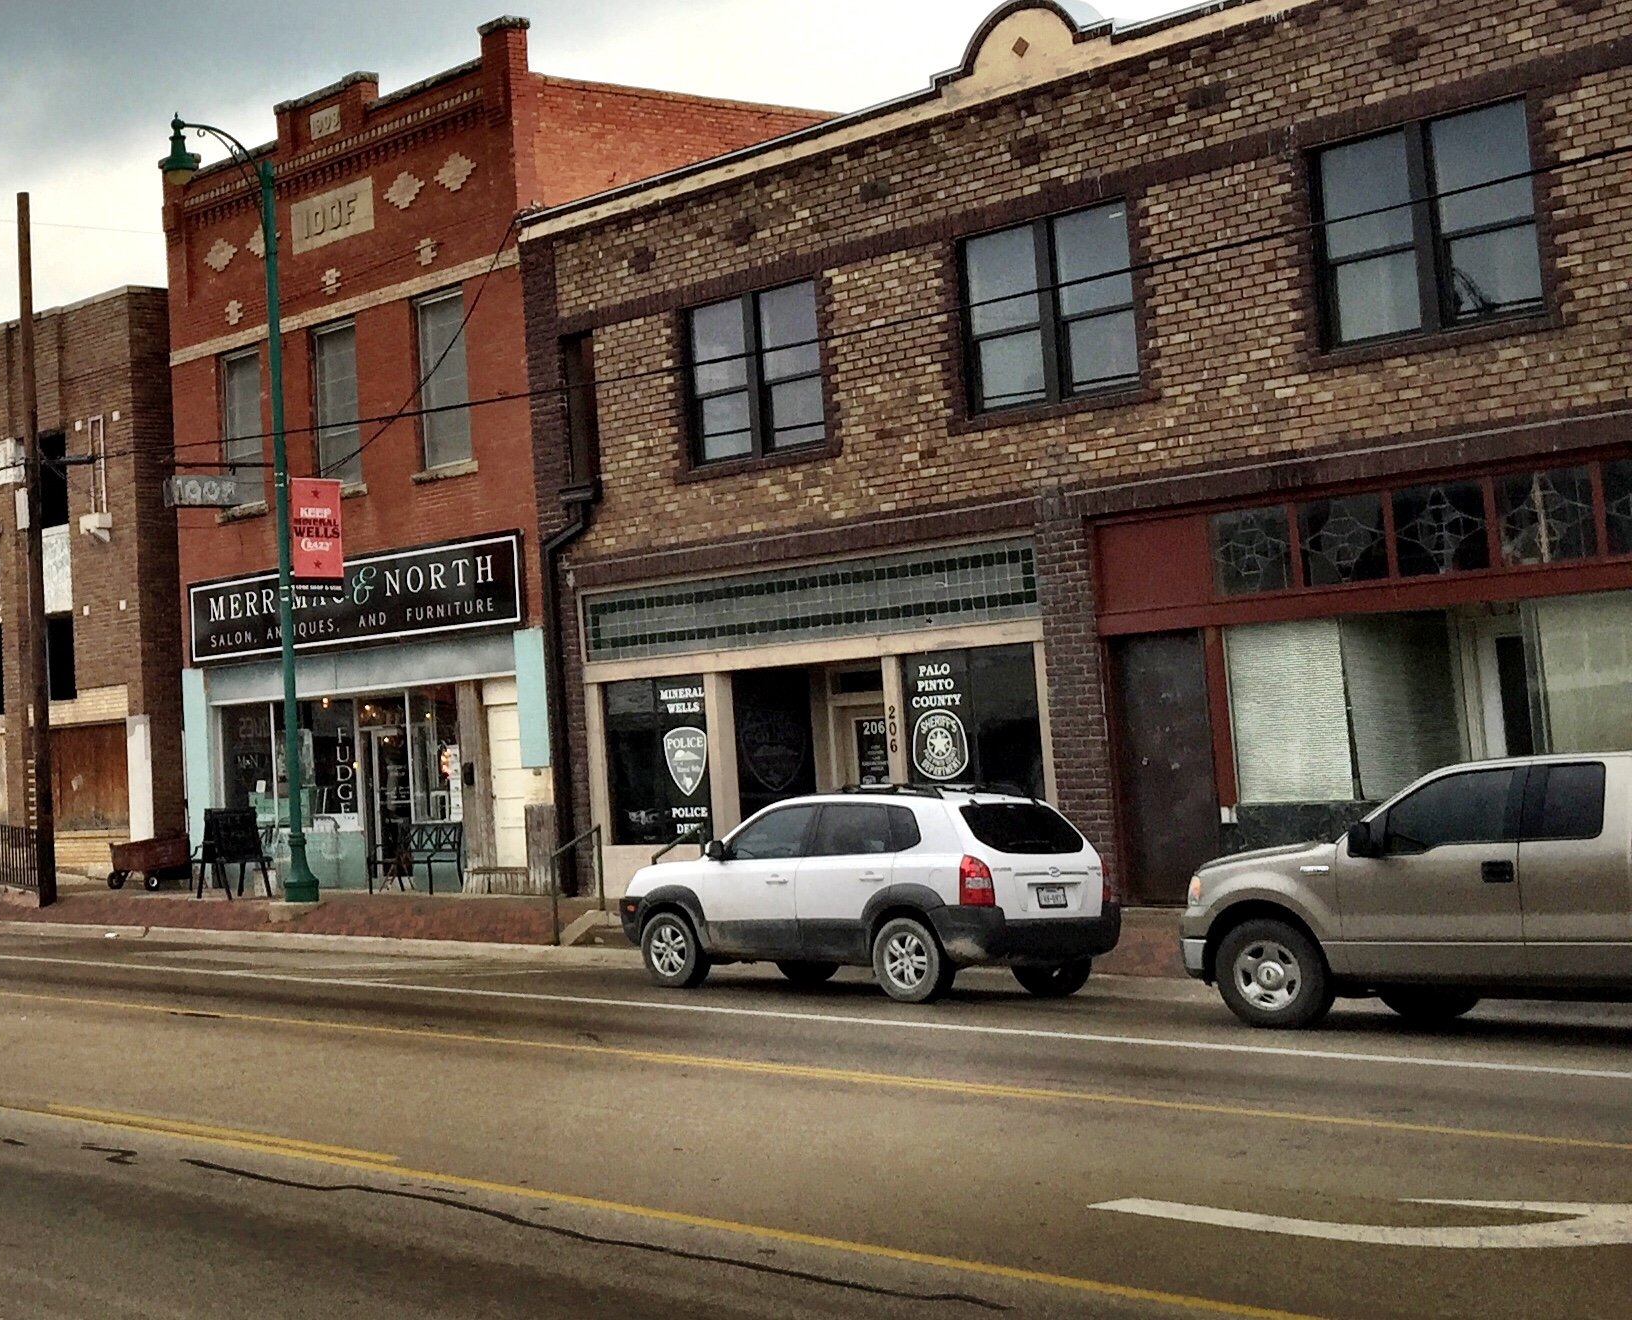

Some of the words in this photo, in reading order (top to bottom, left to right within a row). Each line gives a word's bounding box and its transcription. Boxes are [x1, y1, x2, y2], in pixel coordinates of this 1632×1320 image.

[293, 526, 340, 538] WELLS
[209, 584, 344, 622] MERRM
[384, 554, 494, 597] NORTH
[266, 618, 341, 640] ANIQUES,
[358, 611, 388, 628] AND
[406, 597, 495, 622] FURNITURE
[918, 662, 950, 677] PALO
[917, 678, 954, 692] PINTO
[660, 687, 705, 700] MINERAL
[667, 701, 700, 714] WELLS
[912, 694, 962, 708] COUNTY
[863, 721, 886, 735] 206
[889, 705, 898, 753] 206
[667, 736, 704, 749] POLICE
[336, 727, 353, 813] FUDGE
[672, 807, 708, 818] POLICE
